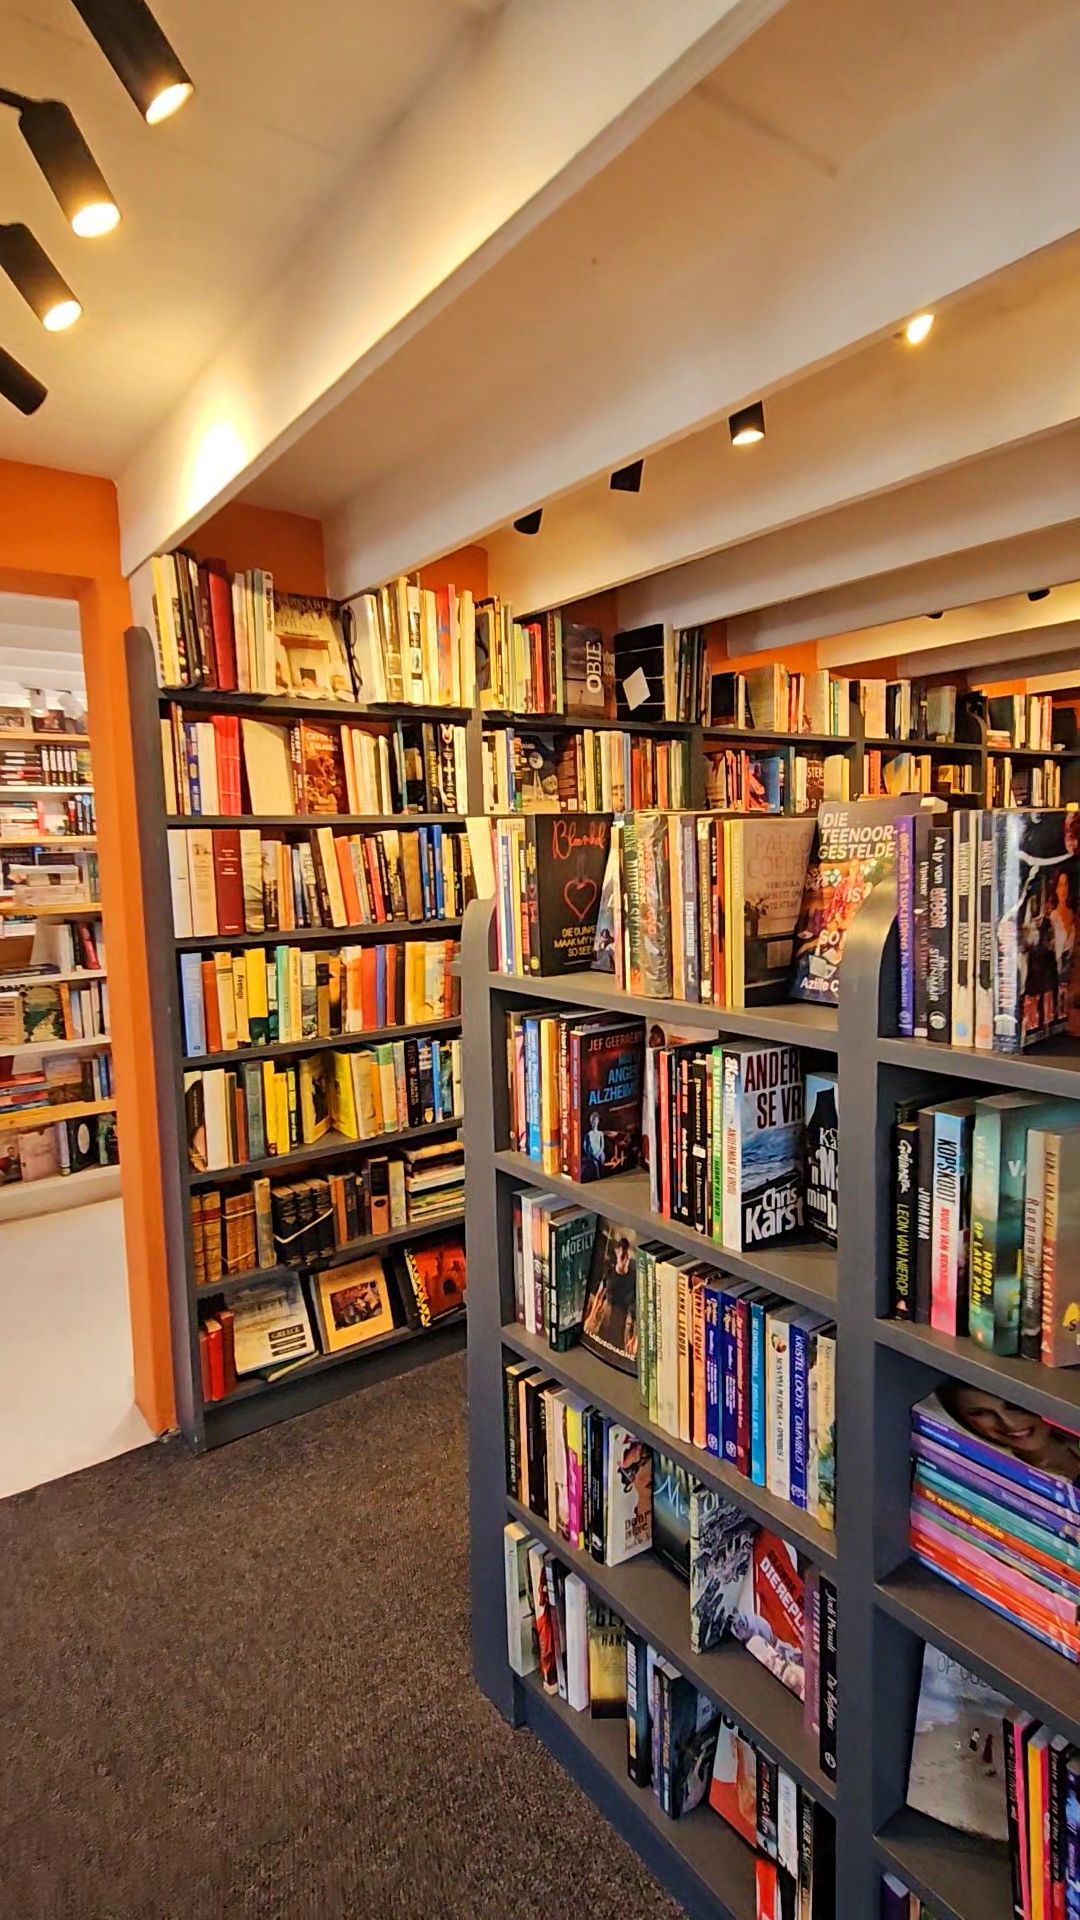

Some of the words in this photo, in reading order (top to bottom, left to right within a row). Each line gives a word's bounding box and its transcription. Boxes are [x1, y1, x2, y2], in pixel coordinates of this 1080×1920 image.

[820, 824, 898, 844] TEENOOR-
[822, 811, 849, 828] DIE
[817, 840, 897, 860] GESTELDE
[933, 836, 946, 851] As
[933, 864, 944, 884] van
[578, 946, 593, 955] SEE
[587, 1037, 604, 1052] JEF
[743, 1048, 801, 1093] ANDER
[756, 1091, 777, 1129] SE
[781, 1085, 802, 1125] VR
[936, 1138, 957, 1205] KOPSKOOT
[761, 1183, 798, 1212] Chris
[918, 1187, 931, 1240] JOHANNA
[745, 1202, 804, 1244] Karst
[896, 1203, 909, 1233] LEON
[973, 1221, 982, 1239] OP
[896, 1234, 909, 1256] VAN
[940, 1234, 950, 1252] VAN
[973, 1241, 982, 1276] LAKE
[895, 1257, 909, 1296] NIEROP
[983, 1250, 993, 1294] MOORD
[678, 1319, 686, 1357] LEROUX
[694, 1323, 702, 1362] LEROUX
[794, 1334, 807, 1373] KRISTEL
[794, 1373, 806, 1409] LOOTS
[794, 1414, 805, 1465] OMNIBUS
